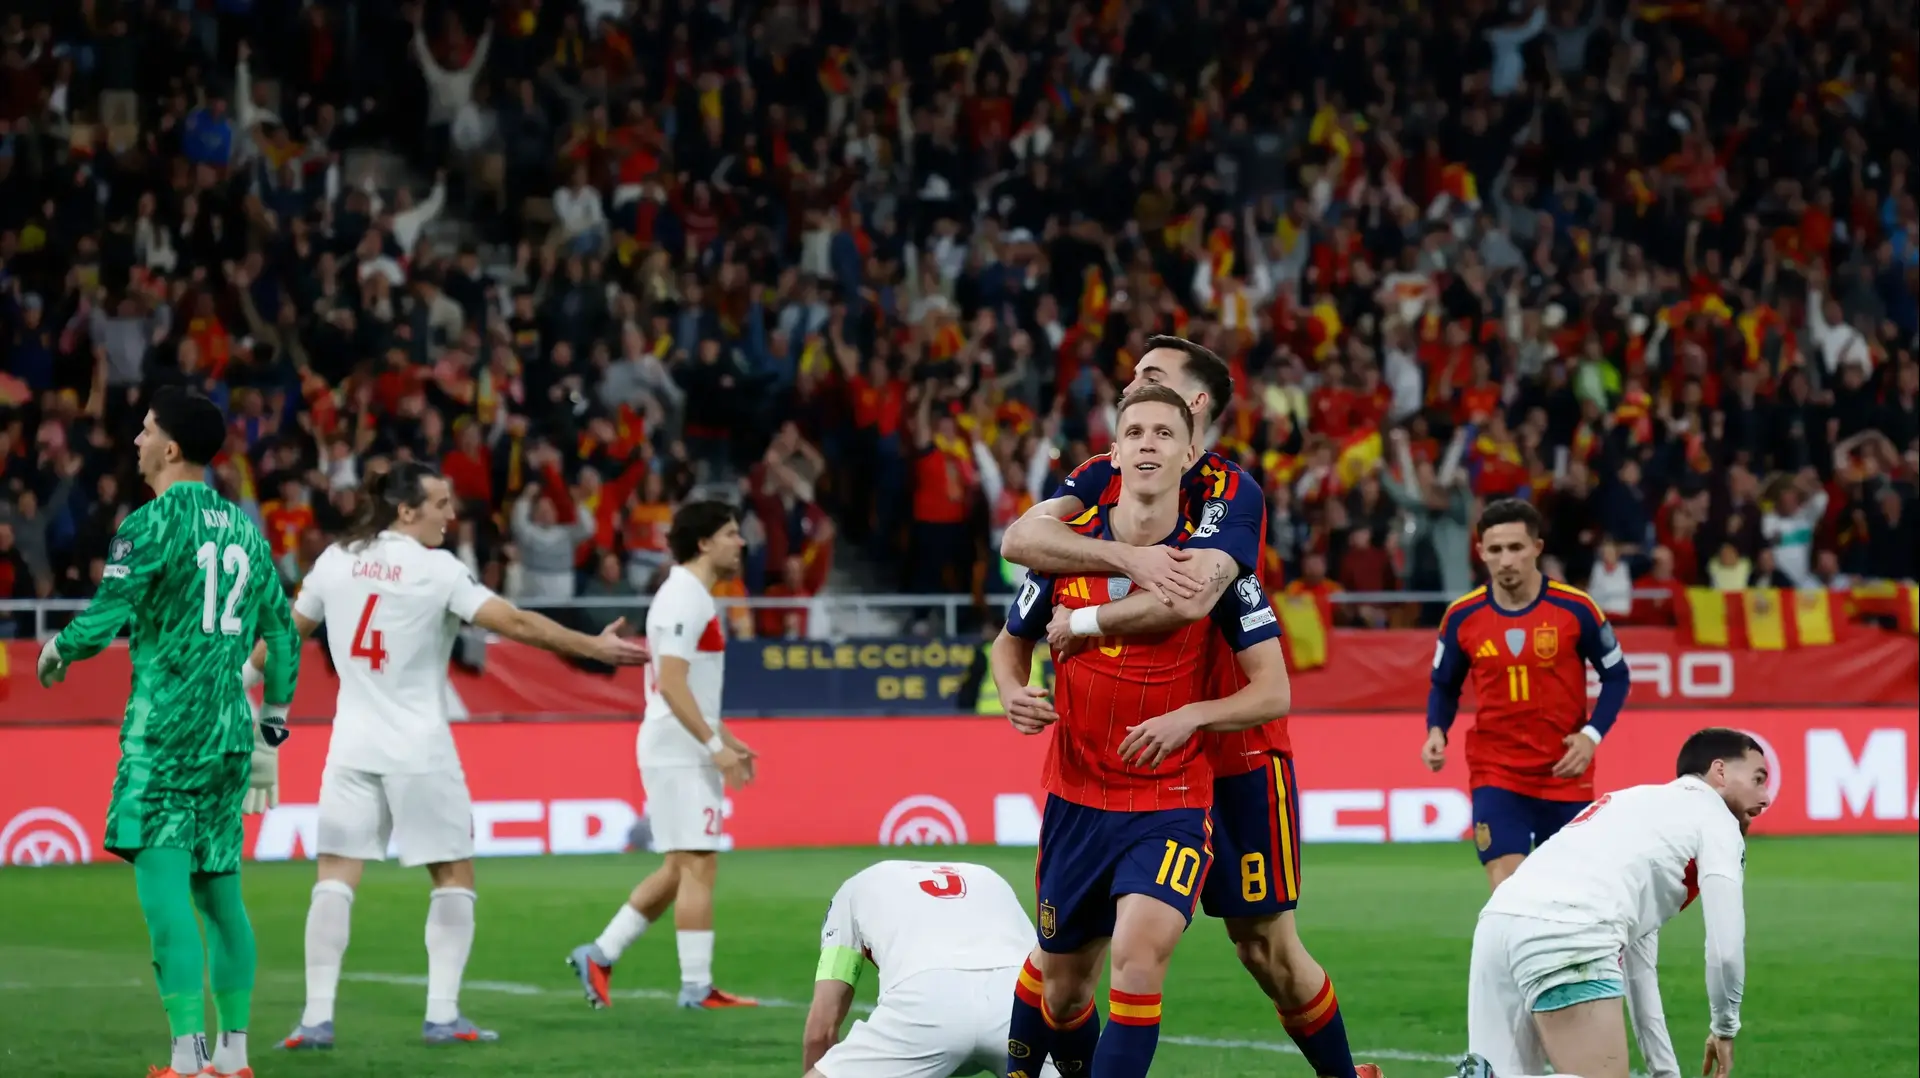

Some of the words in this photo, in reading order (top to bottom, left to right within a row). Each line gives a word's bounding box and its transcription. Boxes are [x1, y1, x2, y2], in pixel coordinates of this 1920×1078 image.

[197, 541, 249, 636] 12
[350, 593, 388, 673] 4
[763, 639, 974, 670] SELECCIÓN
[877, 676, 925, 699] DE
[938, 674, 969, 698] F
[1507, 665, 1529, 701] 11
[1155, 839, 1200, 897] 10
[1241, 852, 1267, 902] 8
